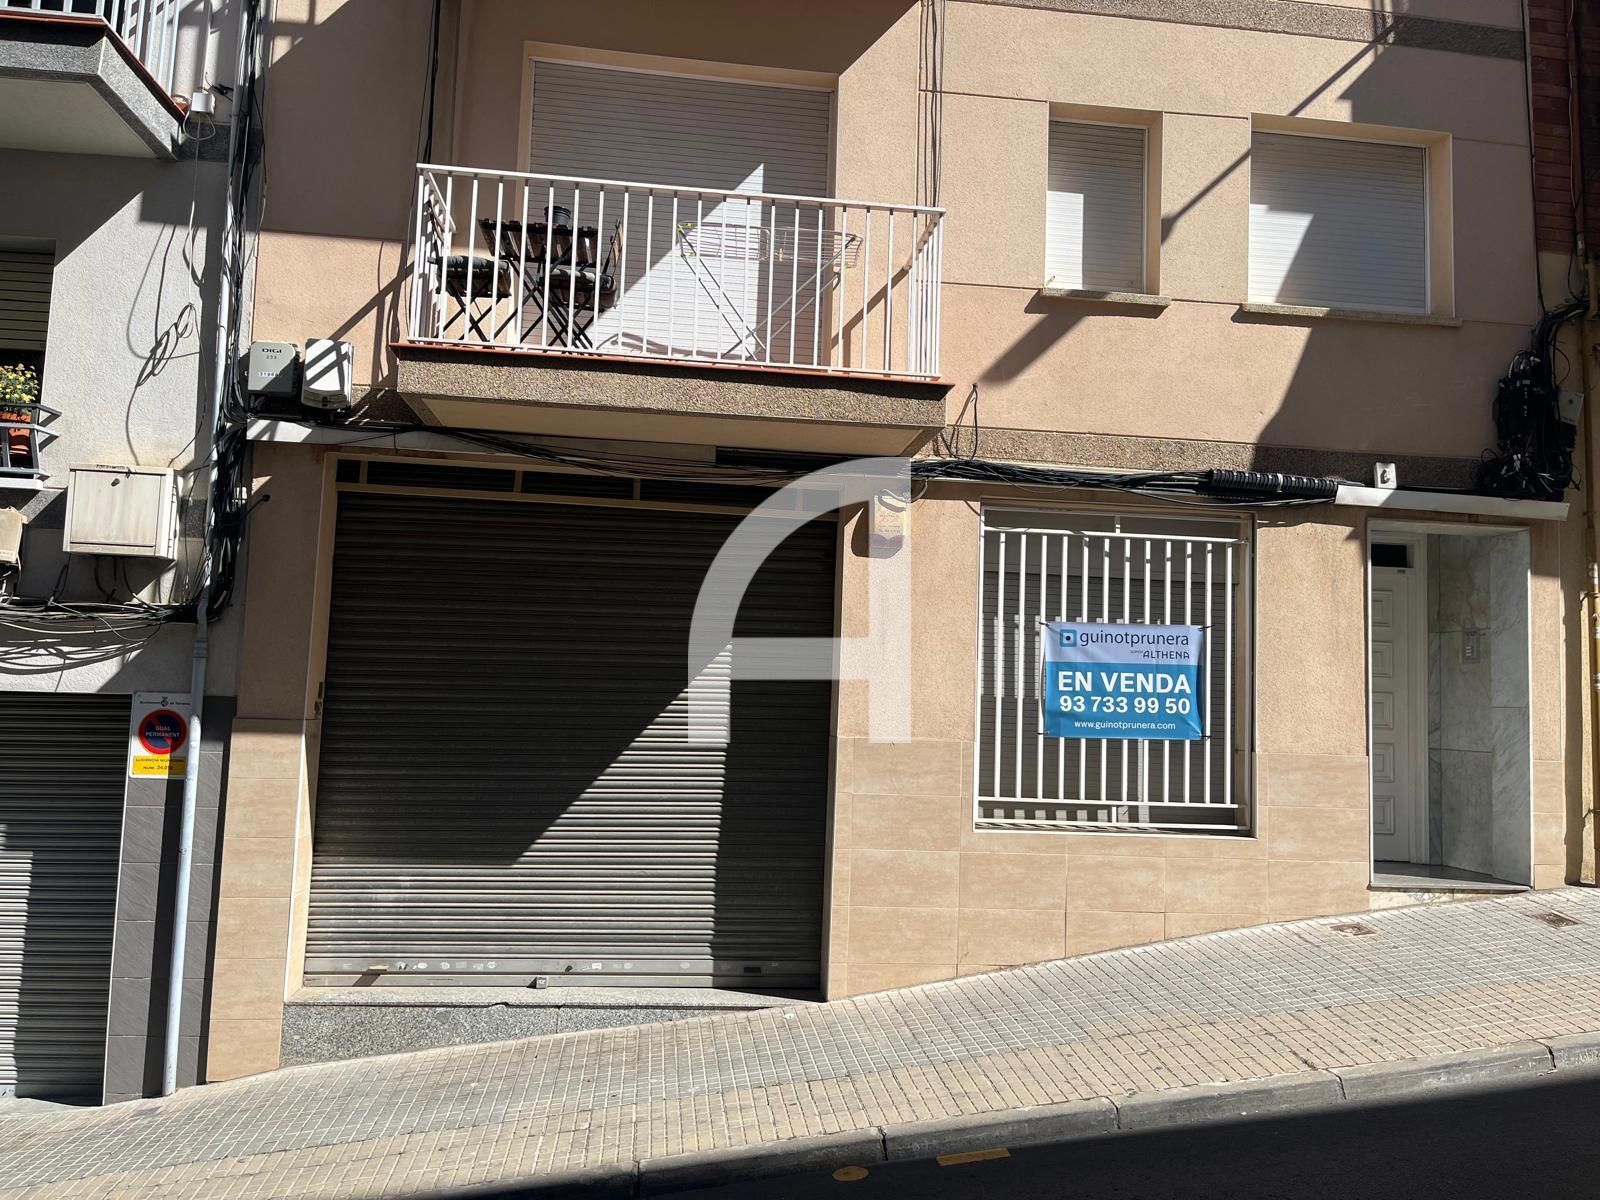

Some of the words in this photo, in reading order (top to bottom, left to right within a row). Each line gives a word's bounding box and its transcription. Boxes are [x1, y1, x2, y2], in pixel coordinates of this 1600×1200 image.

[1079, 630, 1189, 647] guinotprunera
[1143, 650, 1190, 660] ALTHENA
[1058, 671, 1092, 692] EN
[1101, 672, 1191, 693] VENDA
[1059, 695, 1085, 712] 93
[1091, 696, 1128, 713] 733
[1134, 697, 1159, 713] 99
[1165, 698, 1190, 714] 50
[1074, 721, 1176, 731] www.guinotprunera.com
